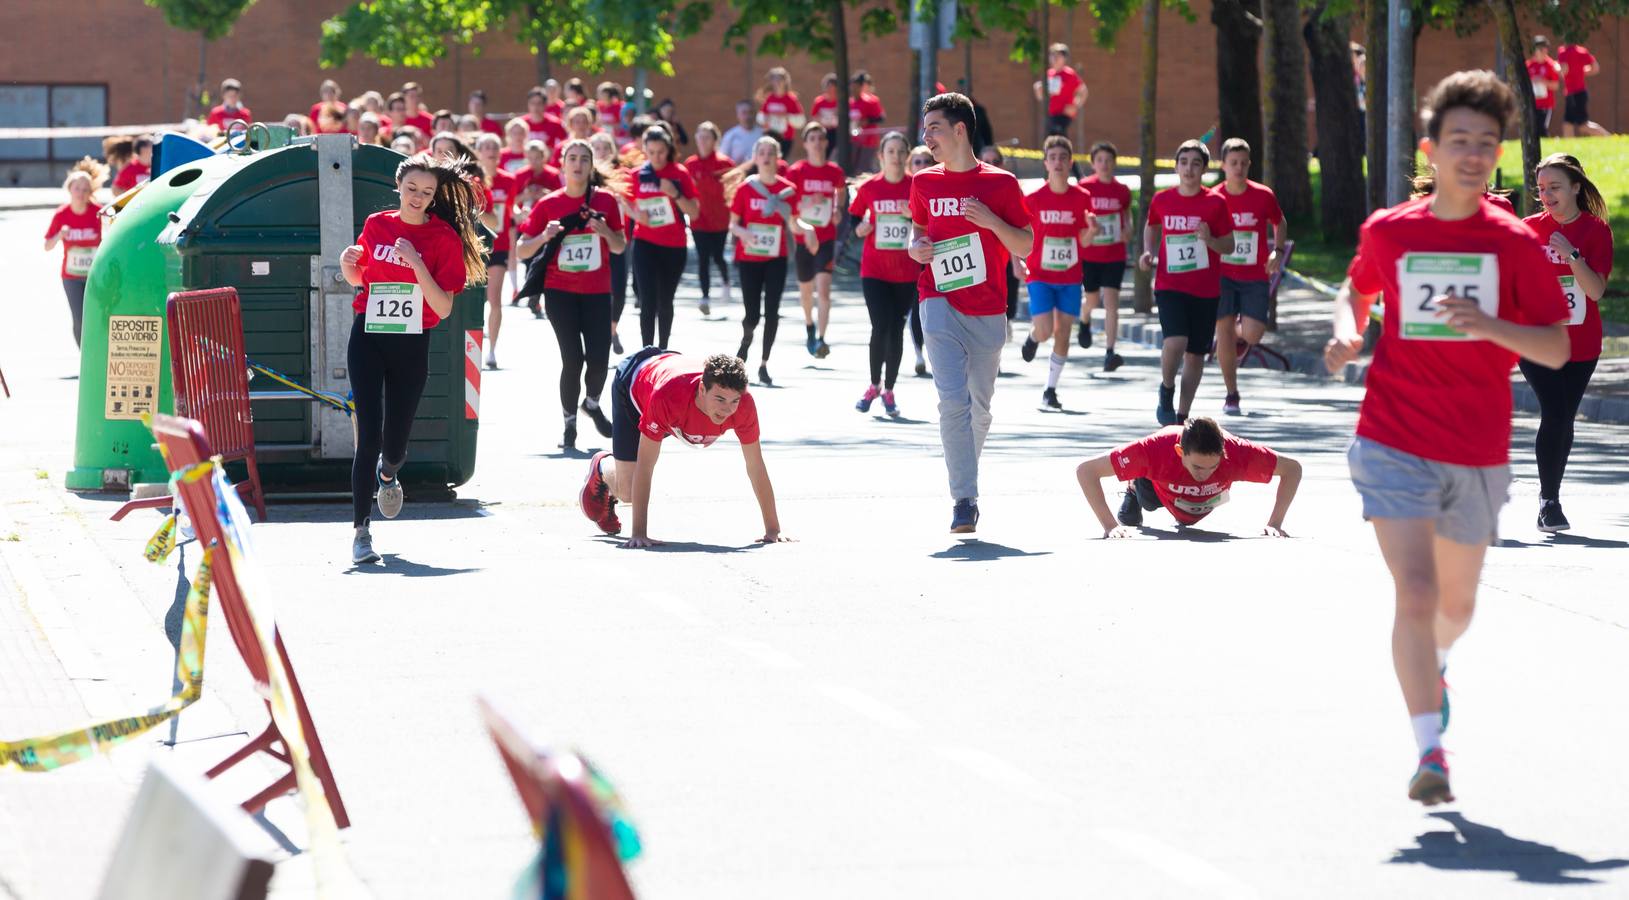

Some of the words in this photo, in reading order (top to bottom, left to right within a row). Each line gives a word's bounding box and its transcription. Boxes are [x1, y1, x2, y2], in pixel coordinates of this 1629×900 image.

[874, 200, 897, 213] UR
[929, 198, 959, 217] UR
[1164, 215, 1187, 230] UR
[884, 226, 908, 238] 309
[566, 247, 593, 261] 147
[1051, 249, 1072, 260] 164
[1178, 246, 1196, 260] 12
[941, 253, 976, 276] 101
[376, 300, 413, 318] 126
[112, 320, 158, 331] DEPOSITE
[112, 332, 130, 341] SOLO
[131, 332, 158, 341] VIDRIO
[109, 361, 126, 376] NO
